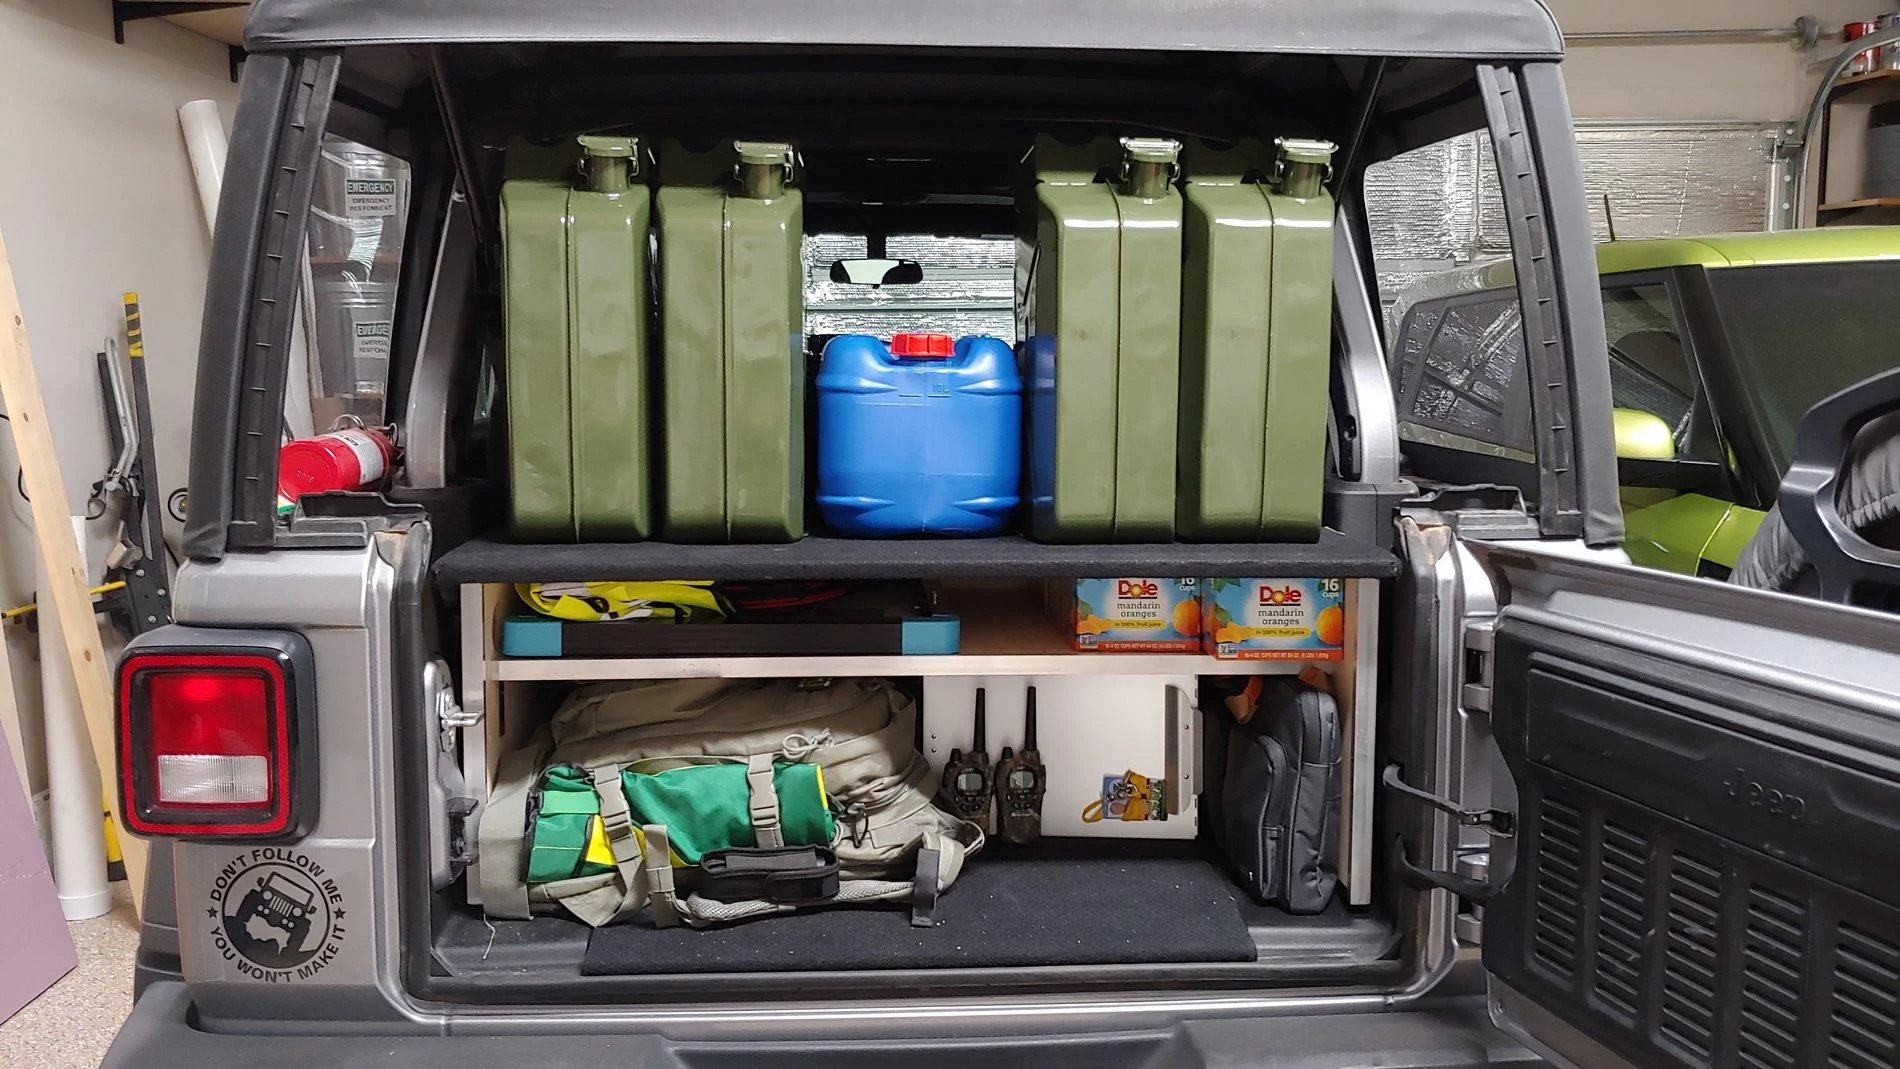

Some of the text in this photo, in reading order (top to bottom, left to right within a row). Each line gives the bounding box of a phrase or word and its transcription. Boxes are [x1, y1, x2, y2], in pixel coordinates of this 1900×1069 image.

[347, 182, 393, 193] EMERGENCY
[1118, 580, 1158, 596] Dole
[1321, 579, 1339, 592] 16
[1260, 586, 1302, 603] Dole
[1321, 591, 1339, 599] cups
[1117, 602, 1160, 610] mandarin
[1120, 611, 1157, 619] oranges
[1258, 608, 1304, 617] mandarin
[1262, 618, 1300, 627] oranges
[1723, 767, 1806, 826] Jeep
[210, 848, 343, 905] DON'T FOLLOW ME
[210, 924, 345, 983] YOU WON'T MAKE IT
